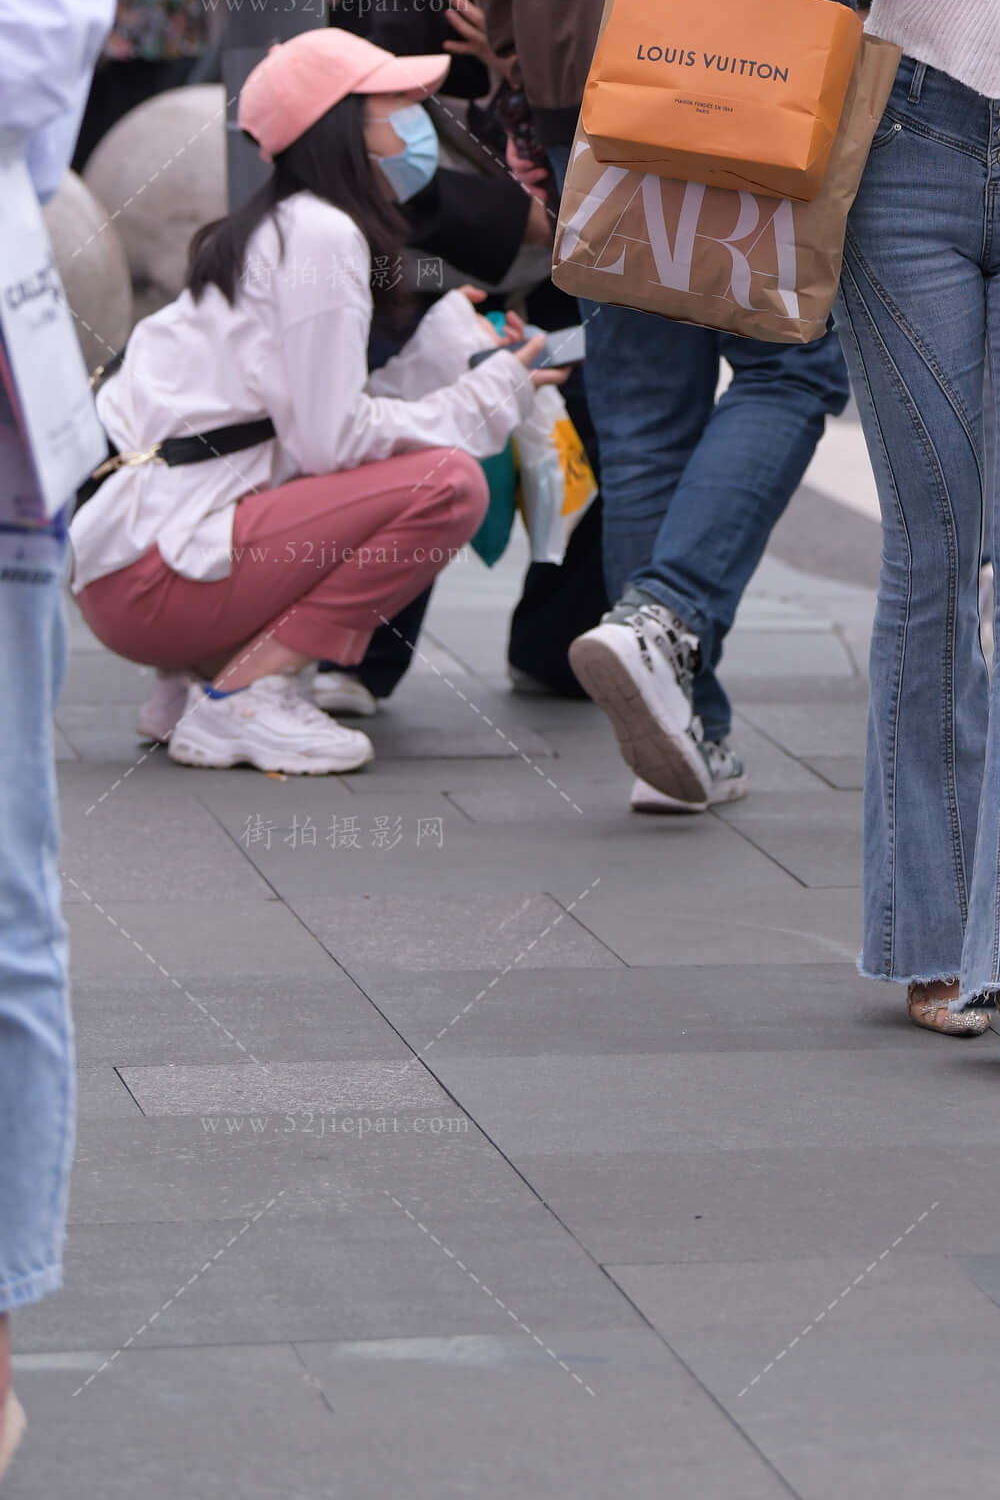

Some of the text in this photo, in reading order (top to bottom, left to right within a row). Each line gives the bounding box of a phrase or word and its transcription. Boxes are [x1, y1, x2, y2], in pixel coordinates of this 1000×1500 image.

[636, 44, 790, 84] LOUIS VUITTON
[561, 141, 808, 322] ZARA
